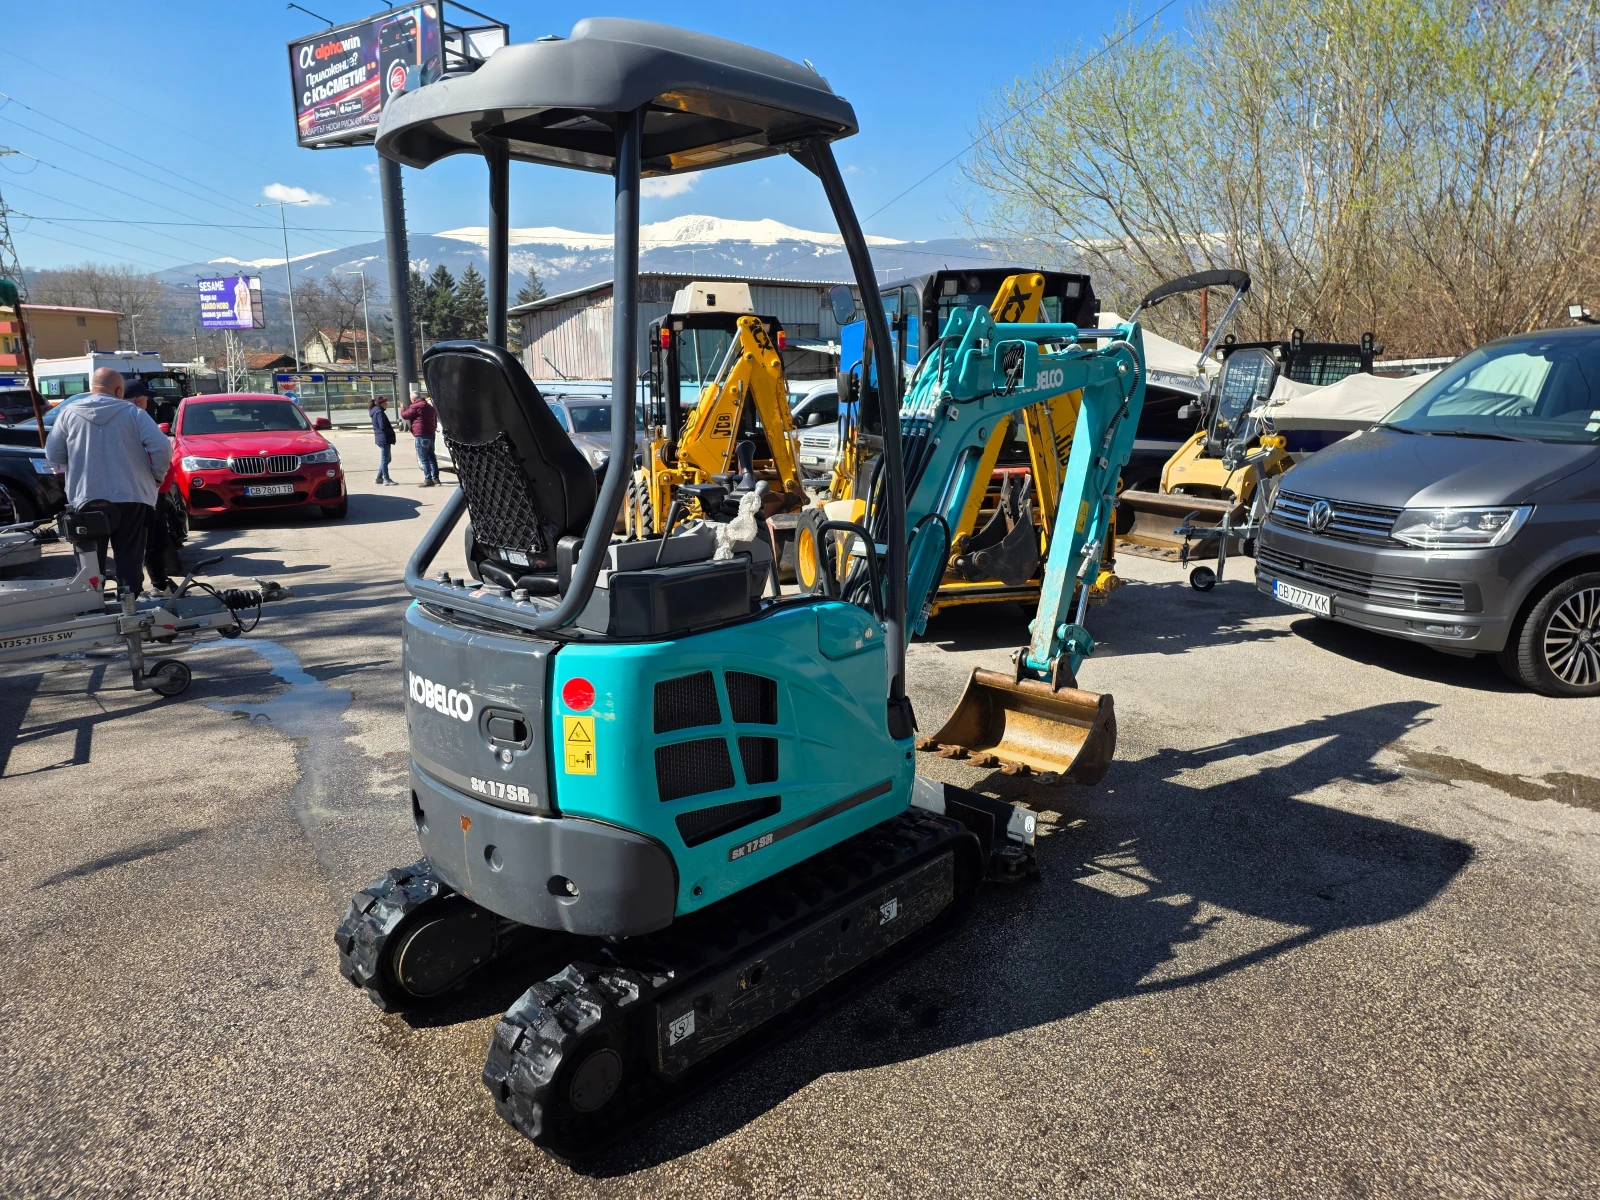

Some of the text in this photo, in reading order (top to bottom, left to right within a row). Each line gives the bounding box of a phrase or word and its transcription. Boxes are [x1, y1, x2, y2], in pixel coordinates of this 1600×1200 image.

[315, 35, 361, 60] alphawin
[306, 52, 358, 87] Приложение?
[312, 66, 366, 103] КЪСМЕТИ!
[326, 121, 340, 131] НОСИ
[341, 118, 355, 127] РИСК
[199, 281, 225, 292] SESAME
[713, 415, 732, 437] JCB
[262, 486, 281, 494] 7801
[1278, 583, 1289, 599] CB
[1290, 587, 1313, 606] 7777
[1314, 595, 1328, 612] KK
[409, 670, 473, 722] KOBELCO
